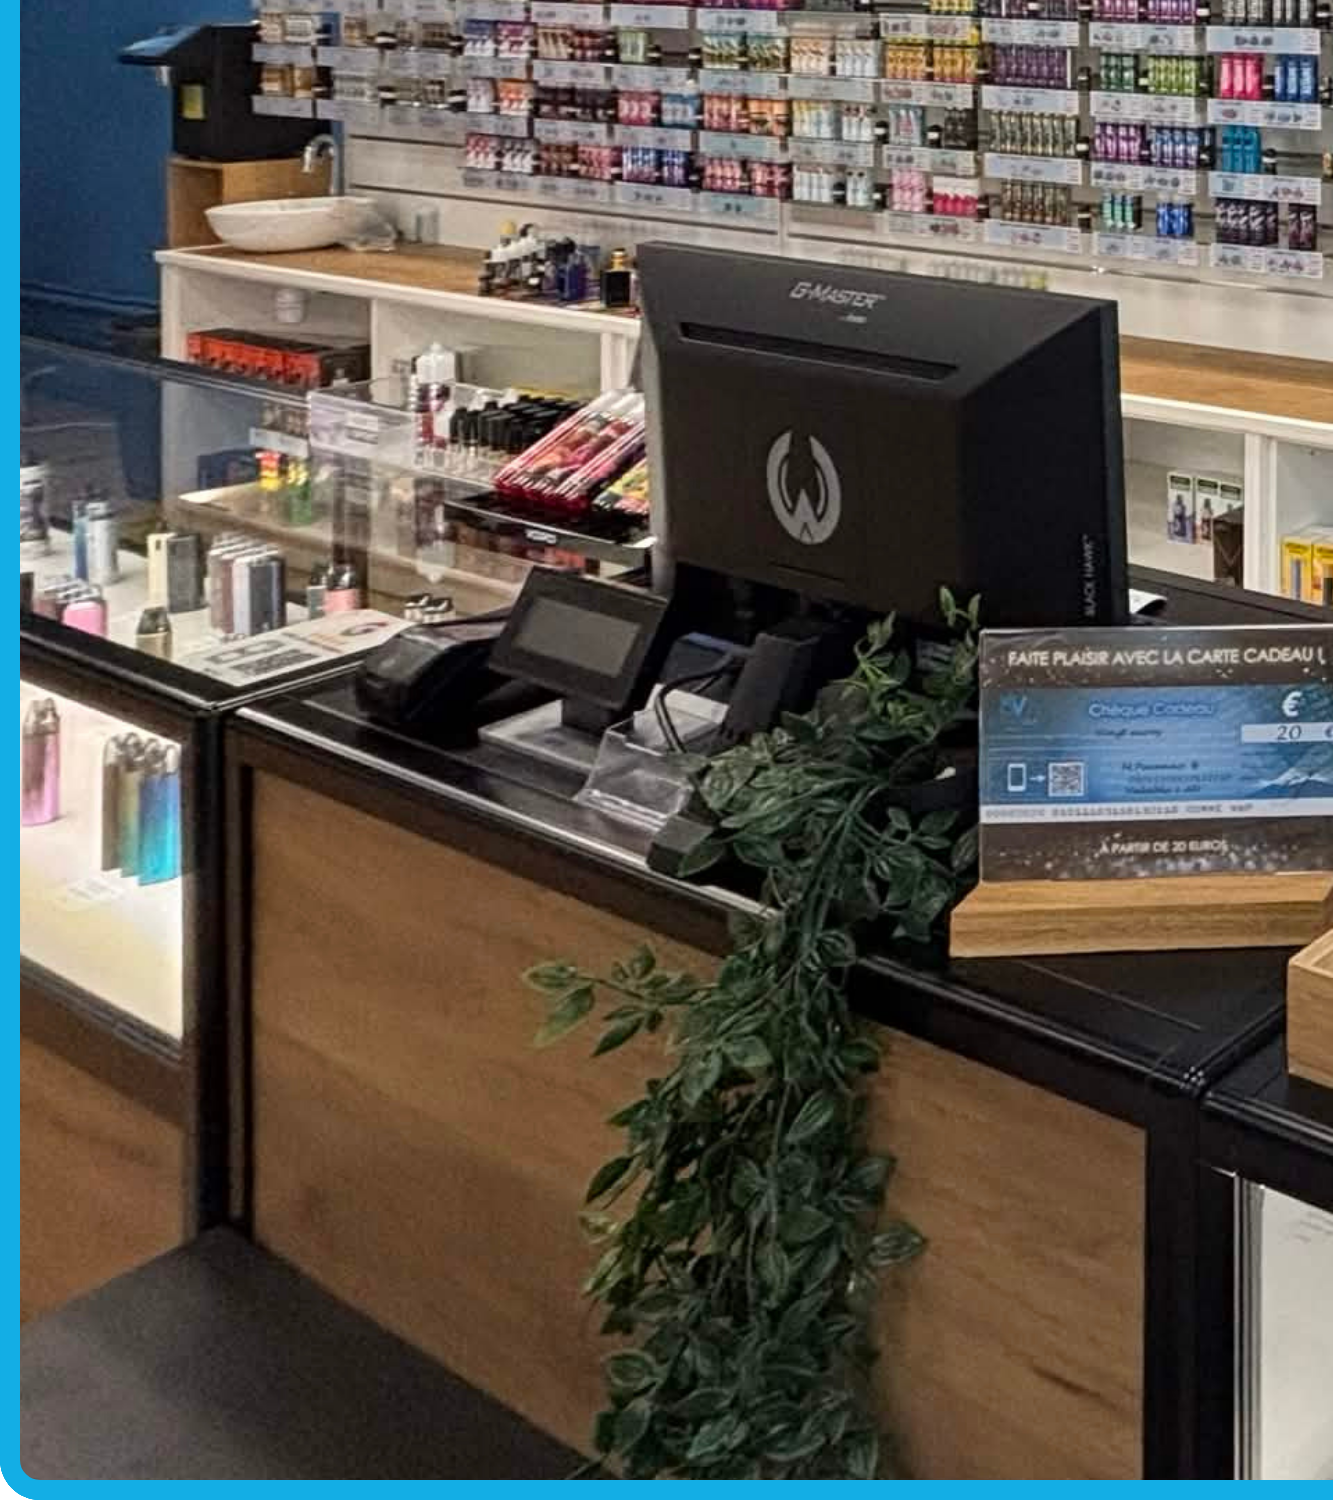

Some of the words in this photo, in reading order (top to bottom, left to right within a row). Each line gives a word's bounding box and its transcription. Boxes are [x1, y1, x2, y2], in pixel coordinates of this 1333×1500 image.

[1008, 652, 1050, 667] FAITE
[1053, 650, 1109, 666] PLAISIR
[1112, 651, 1160, 665] AVEC
[1163, 651, 1184, 665] LA
[1187, 649, 1239, 664] CARTE
[1243, 648, 1313, 663] CADEAU
[1281, 691, 1303, 718] €
[1276, 725, 1302, 740] 20
